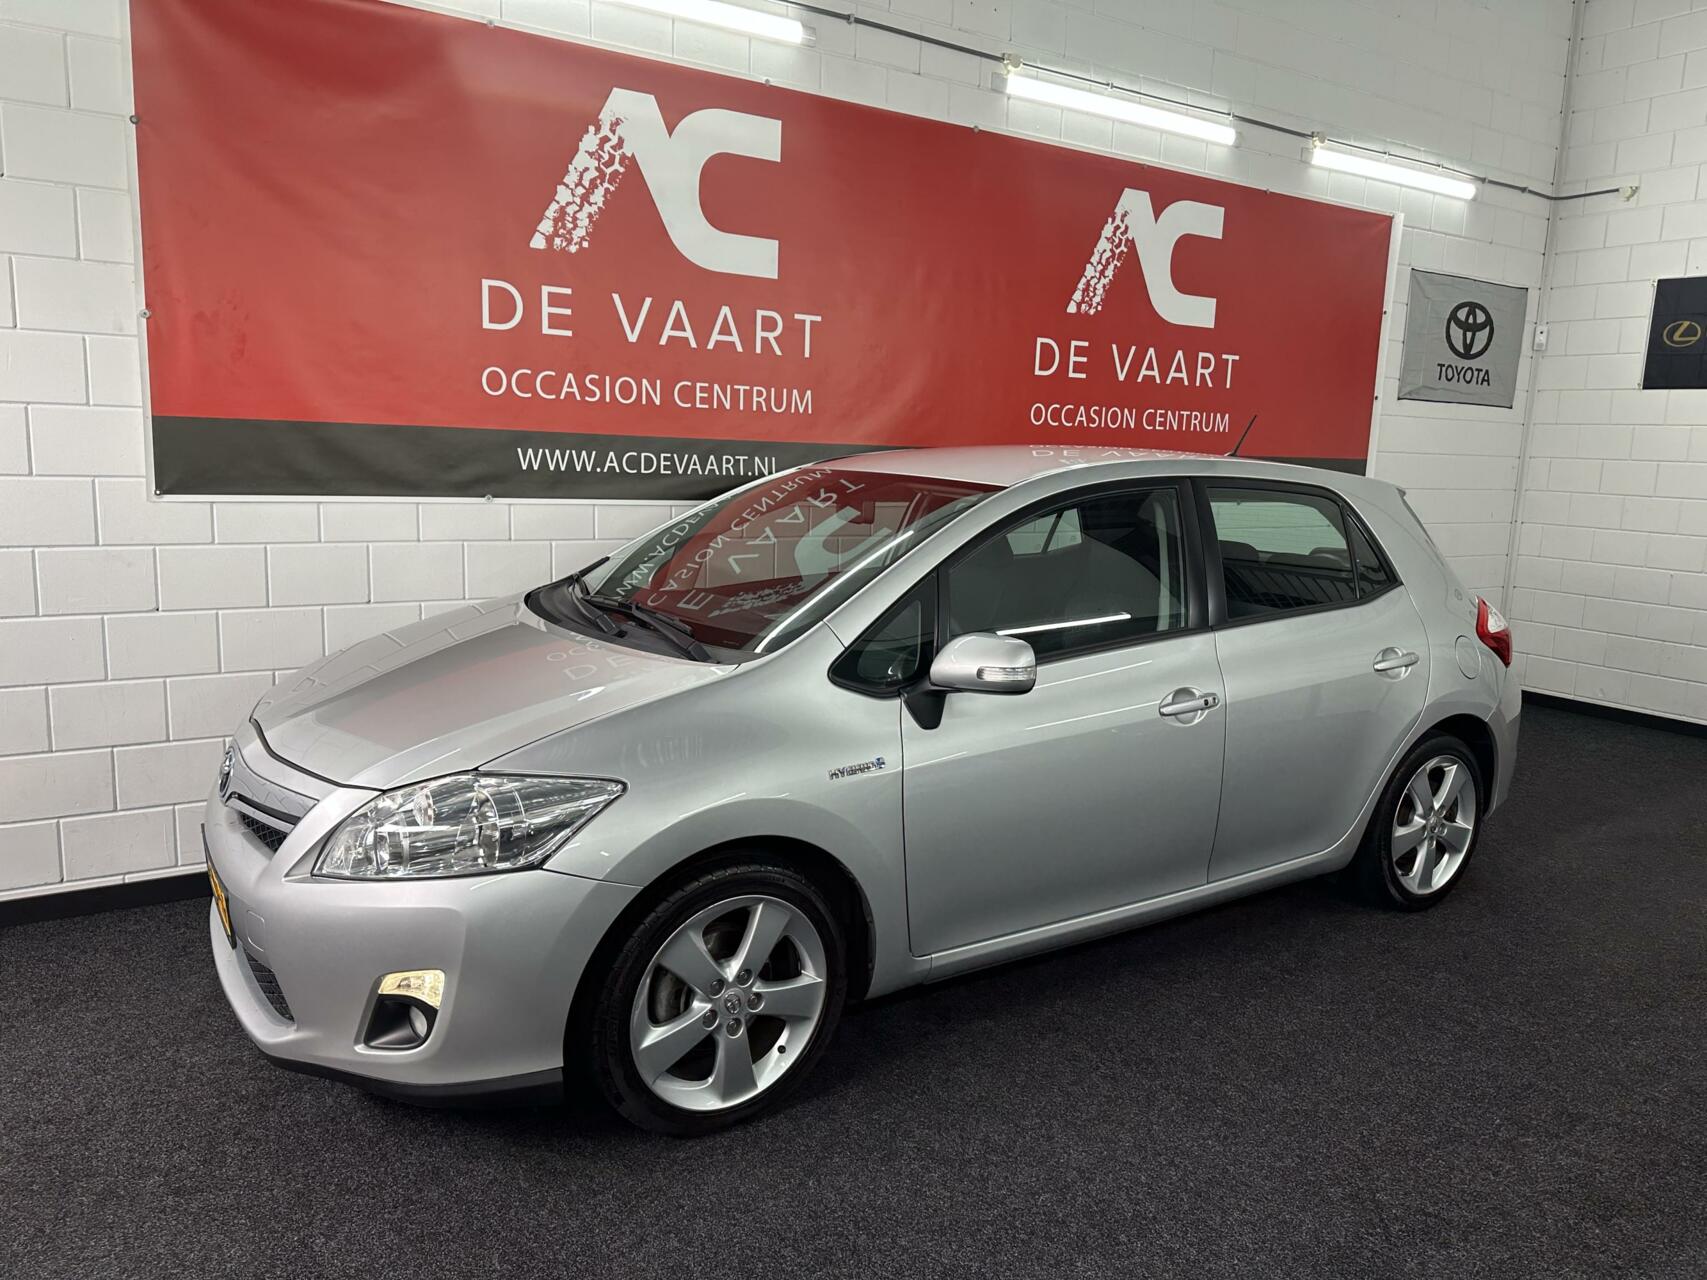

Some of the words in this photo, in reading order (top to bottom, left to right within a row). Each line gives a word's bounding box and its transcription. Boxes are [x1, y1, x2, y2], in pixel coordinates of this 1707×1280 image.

[529, 87, 782, 280] AC
[1066, 187, 1225, 329] AC
[481, 278, 573, 338] DE
[611, 292, 822, 359] VAART
[1033, 336, 1090, 379] DE
[1111, 343, 1240, 390] VAART
[1436, 362, 1491, 387] TOYOTA
[481, 366, 661, 406] OCCASION
[673, 380, 813, 415] CENTRUM
[1030, 402, 1136, 430] OCCASION
[1142, 408, 1230, 434] CENTRUM
